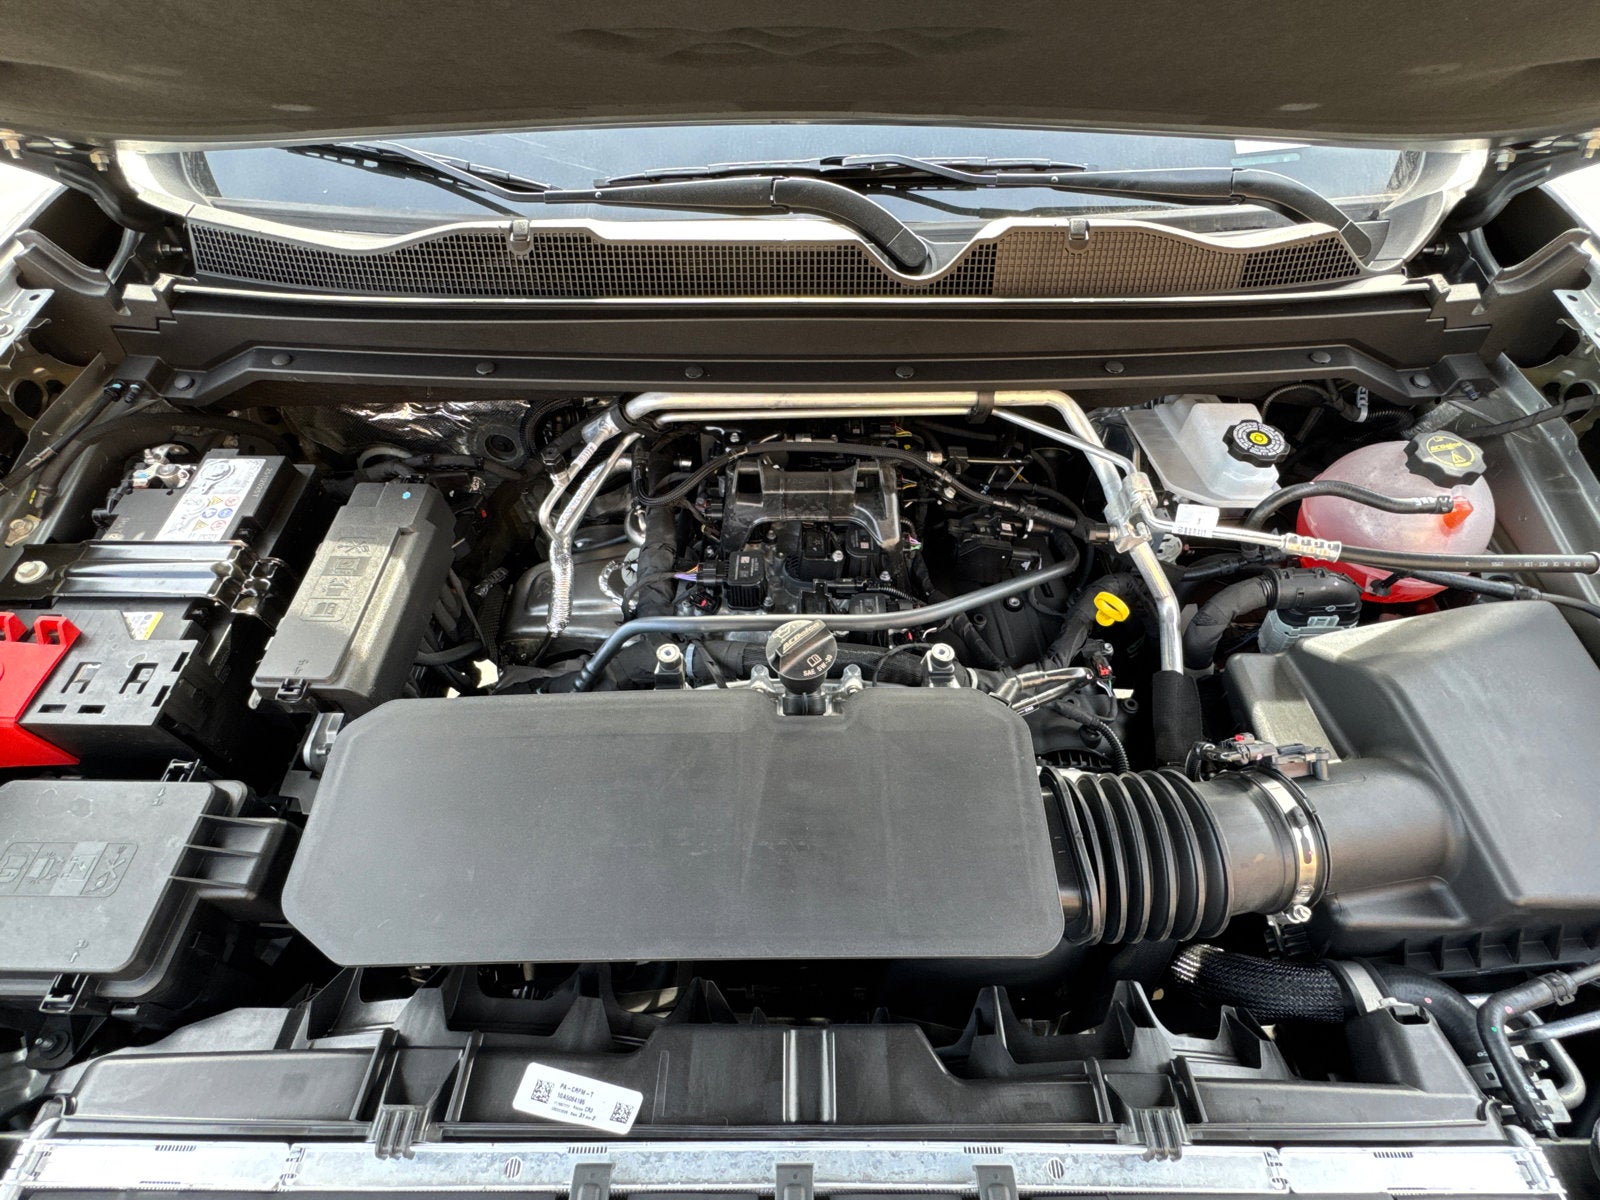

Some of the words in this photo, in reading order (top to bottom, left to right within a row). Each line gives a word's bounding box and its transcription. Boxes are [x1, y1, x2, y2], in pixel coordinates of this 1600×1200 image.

[782, 621, 821, 654] ACDelco
[803, 668, 816, 677] SAE
[816, 654, 833, 672] 5W-30
